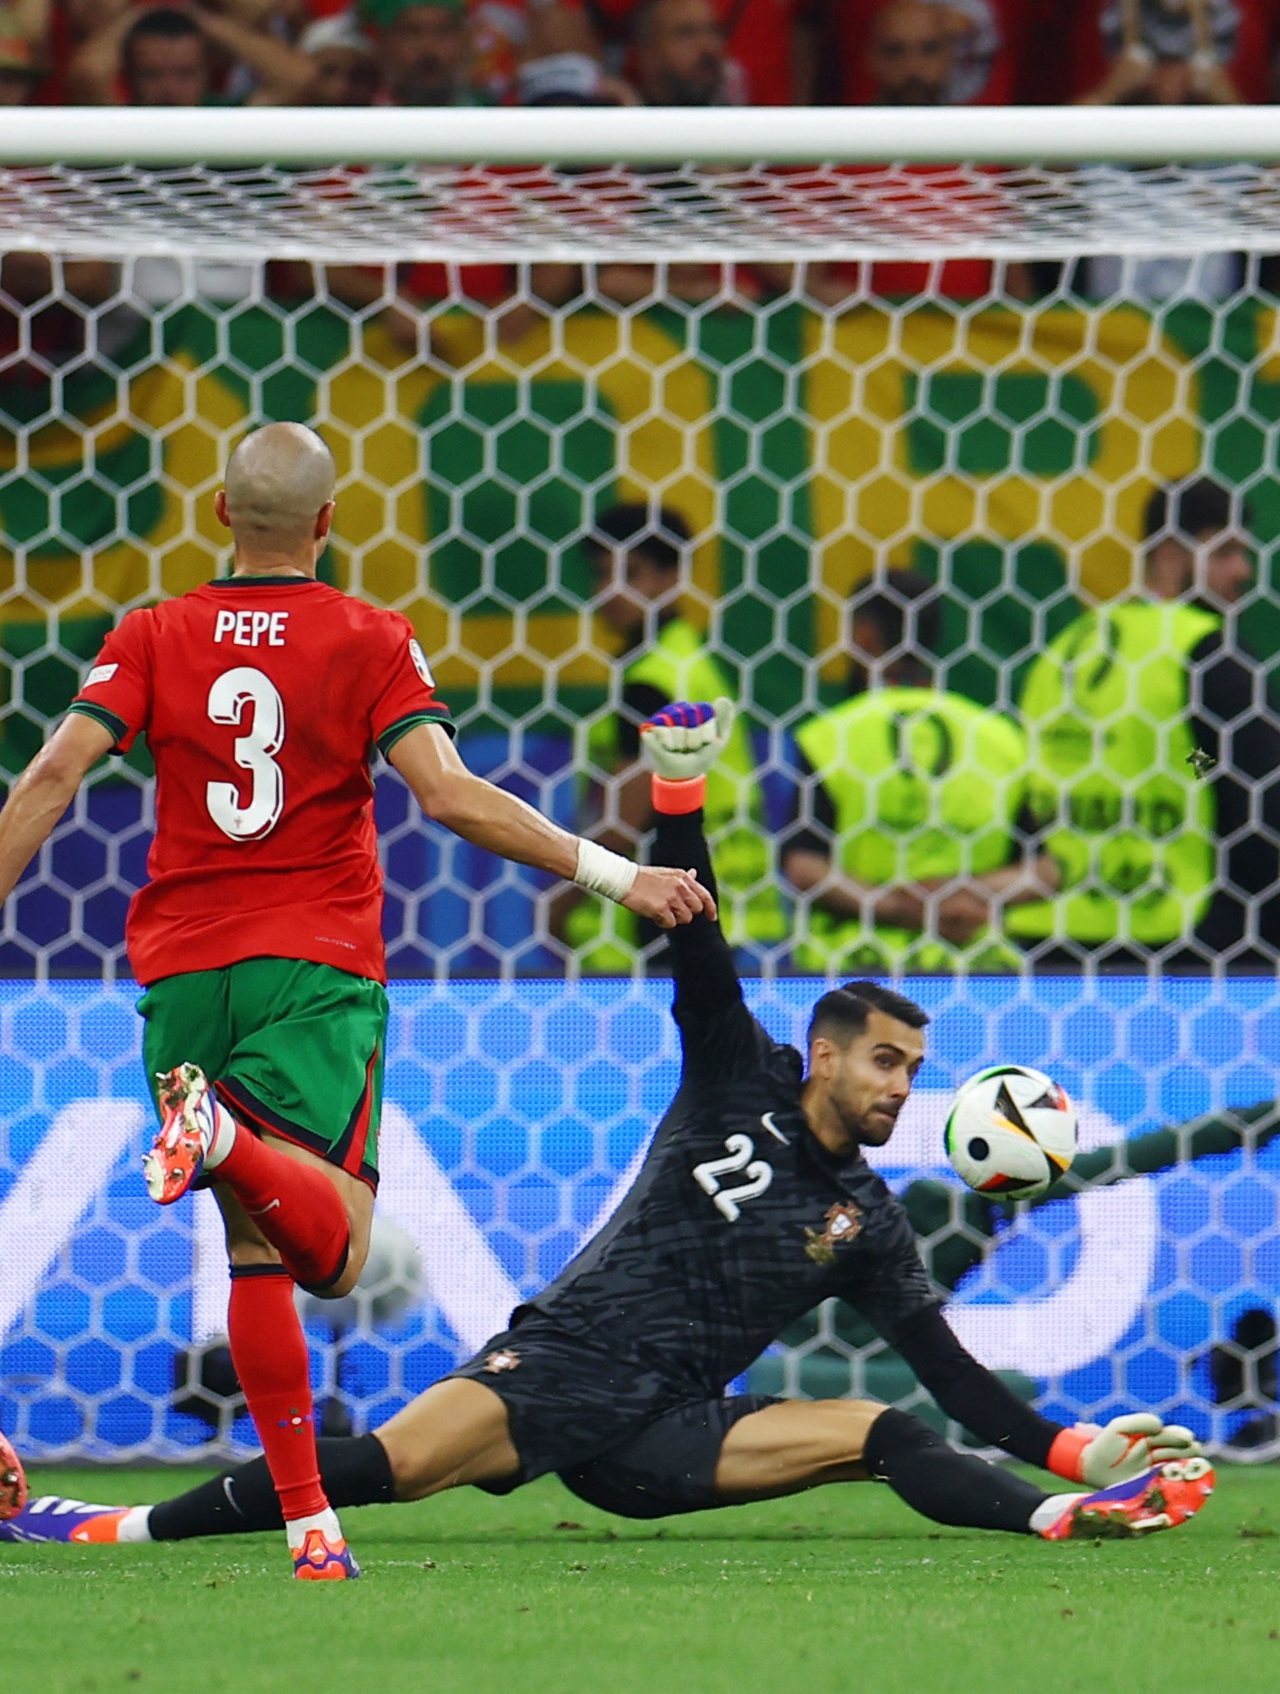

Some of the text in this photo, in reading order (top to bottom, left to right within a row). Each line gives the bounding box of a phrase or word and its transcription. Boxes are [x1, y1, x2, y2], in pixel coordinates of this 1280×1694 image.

[214, 610, 289, 647] PEPE
[206, 666, 285, 842] 3
[692, 1133, 773, 1222] 22
